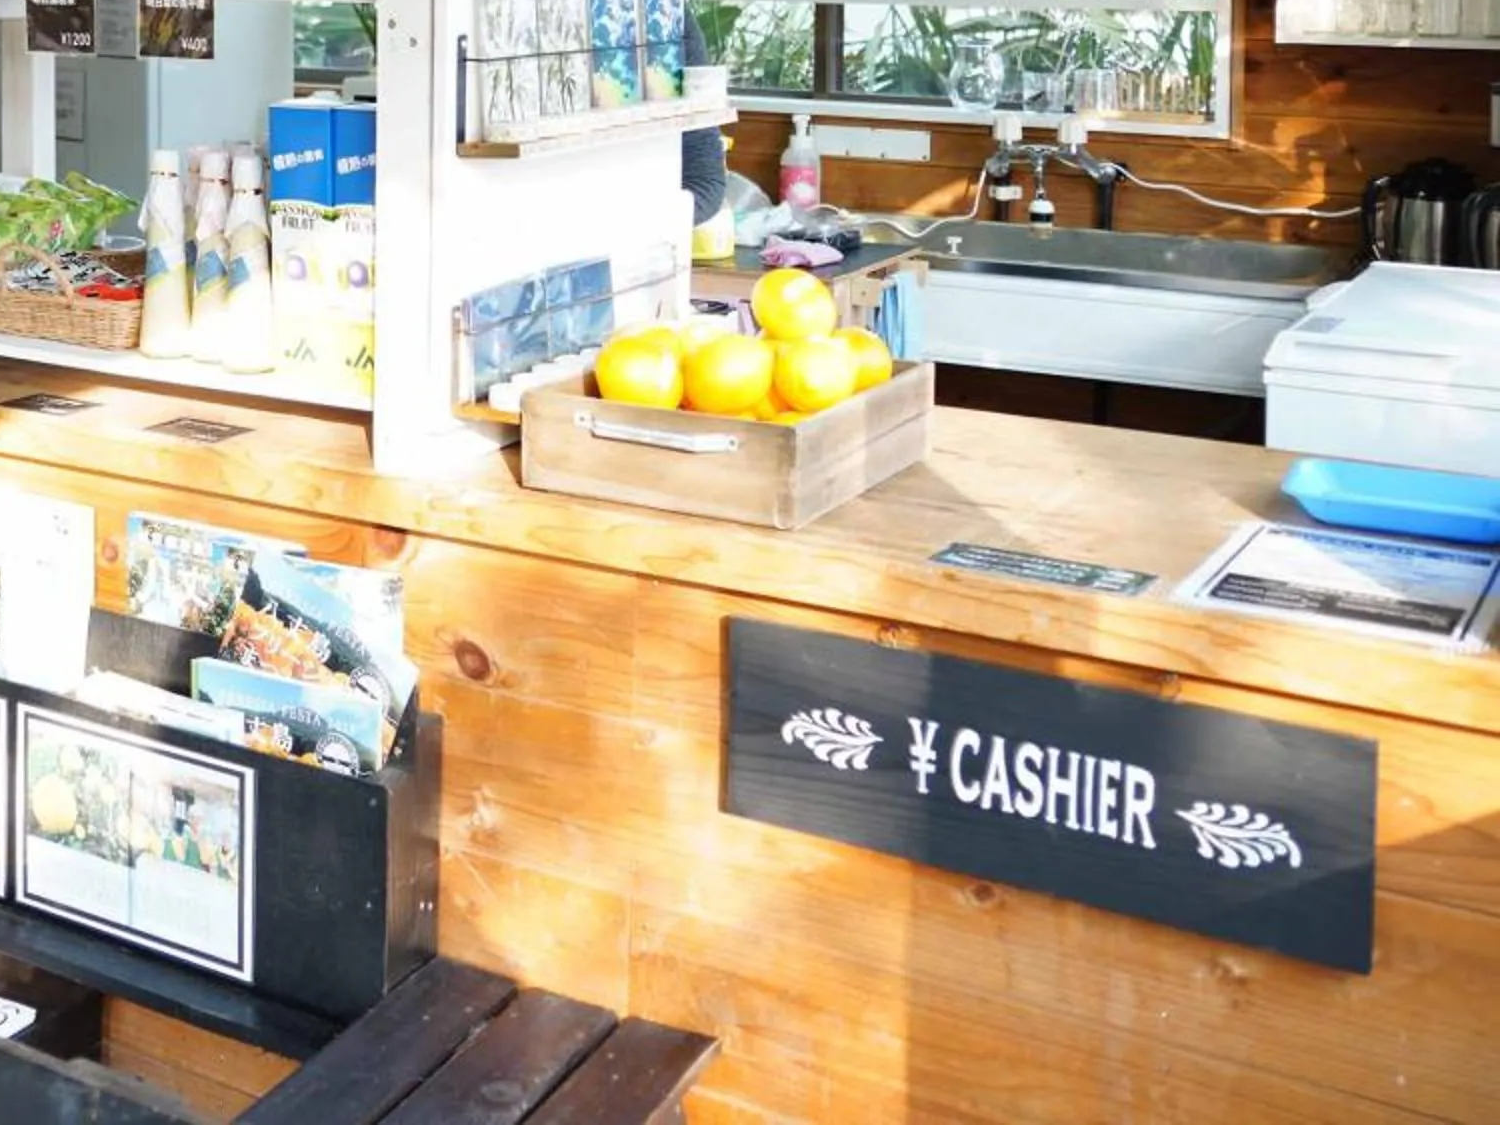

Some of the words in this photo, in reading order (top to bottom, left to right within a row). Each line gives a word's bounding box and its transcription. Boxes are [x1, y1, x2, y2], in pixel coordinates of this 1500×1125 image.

[61, 31, 91, 47] ¥1200
[181, 37, 208, 52] ¥400
[949, 728, 1159, 849] CASHIER
